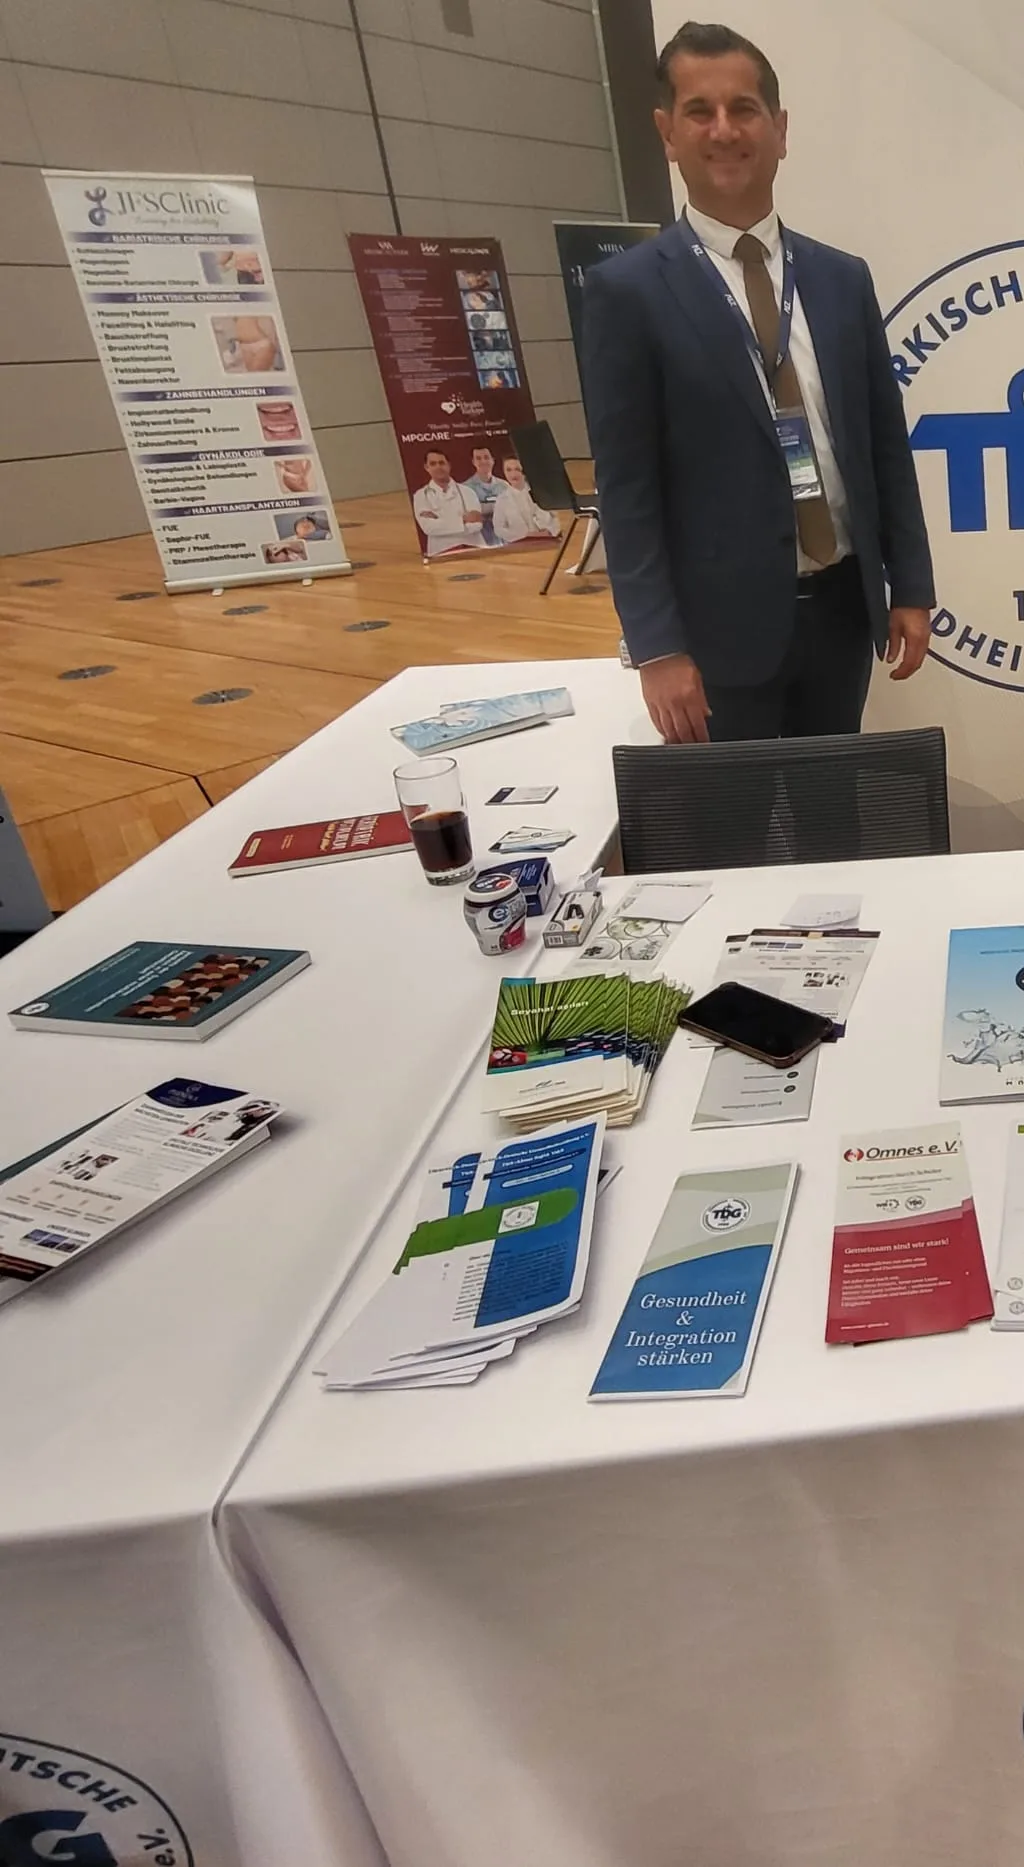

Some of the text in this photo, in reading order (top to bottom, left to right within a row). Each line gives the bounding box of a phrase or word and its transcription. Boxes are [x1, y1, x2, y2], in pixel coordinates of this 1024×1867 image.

[891, 270, 1024, 387] RKISCH
[866, 1145, 924, 1159] Omnes
[711, 1208, 742, 1220] TDG
[844, 1246, 892, 1255] Gemeinsam
[640, 1290, 747, 1309] Gesundheit
[676, 1310, 694, 1326] &
[625, 1328, 737, 1350] Integration
[637, 1348, 713, 1366] stärken
[0, 1748, 138, 1813] TSCHE
